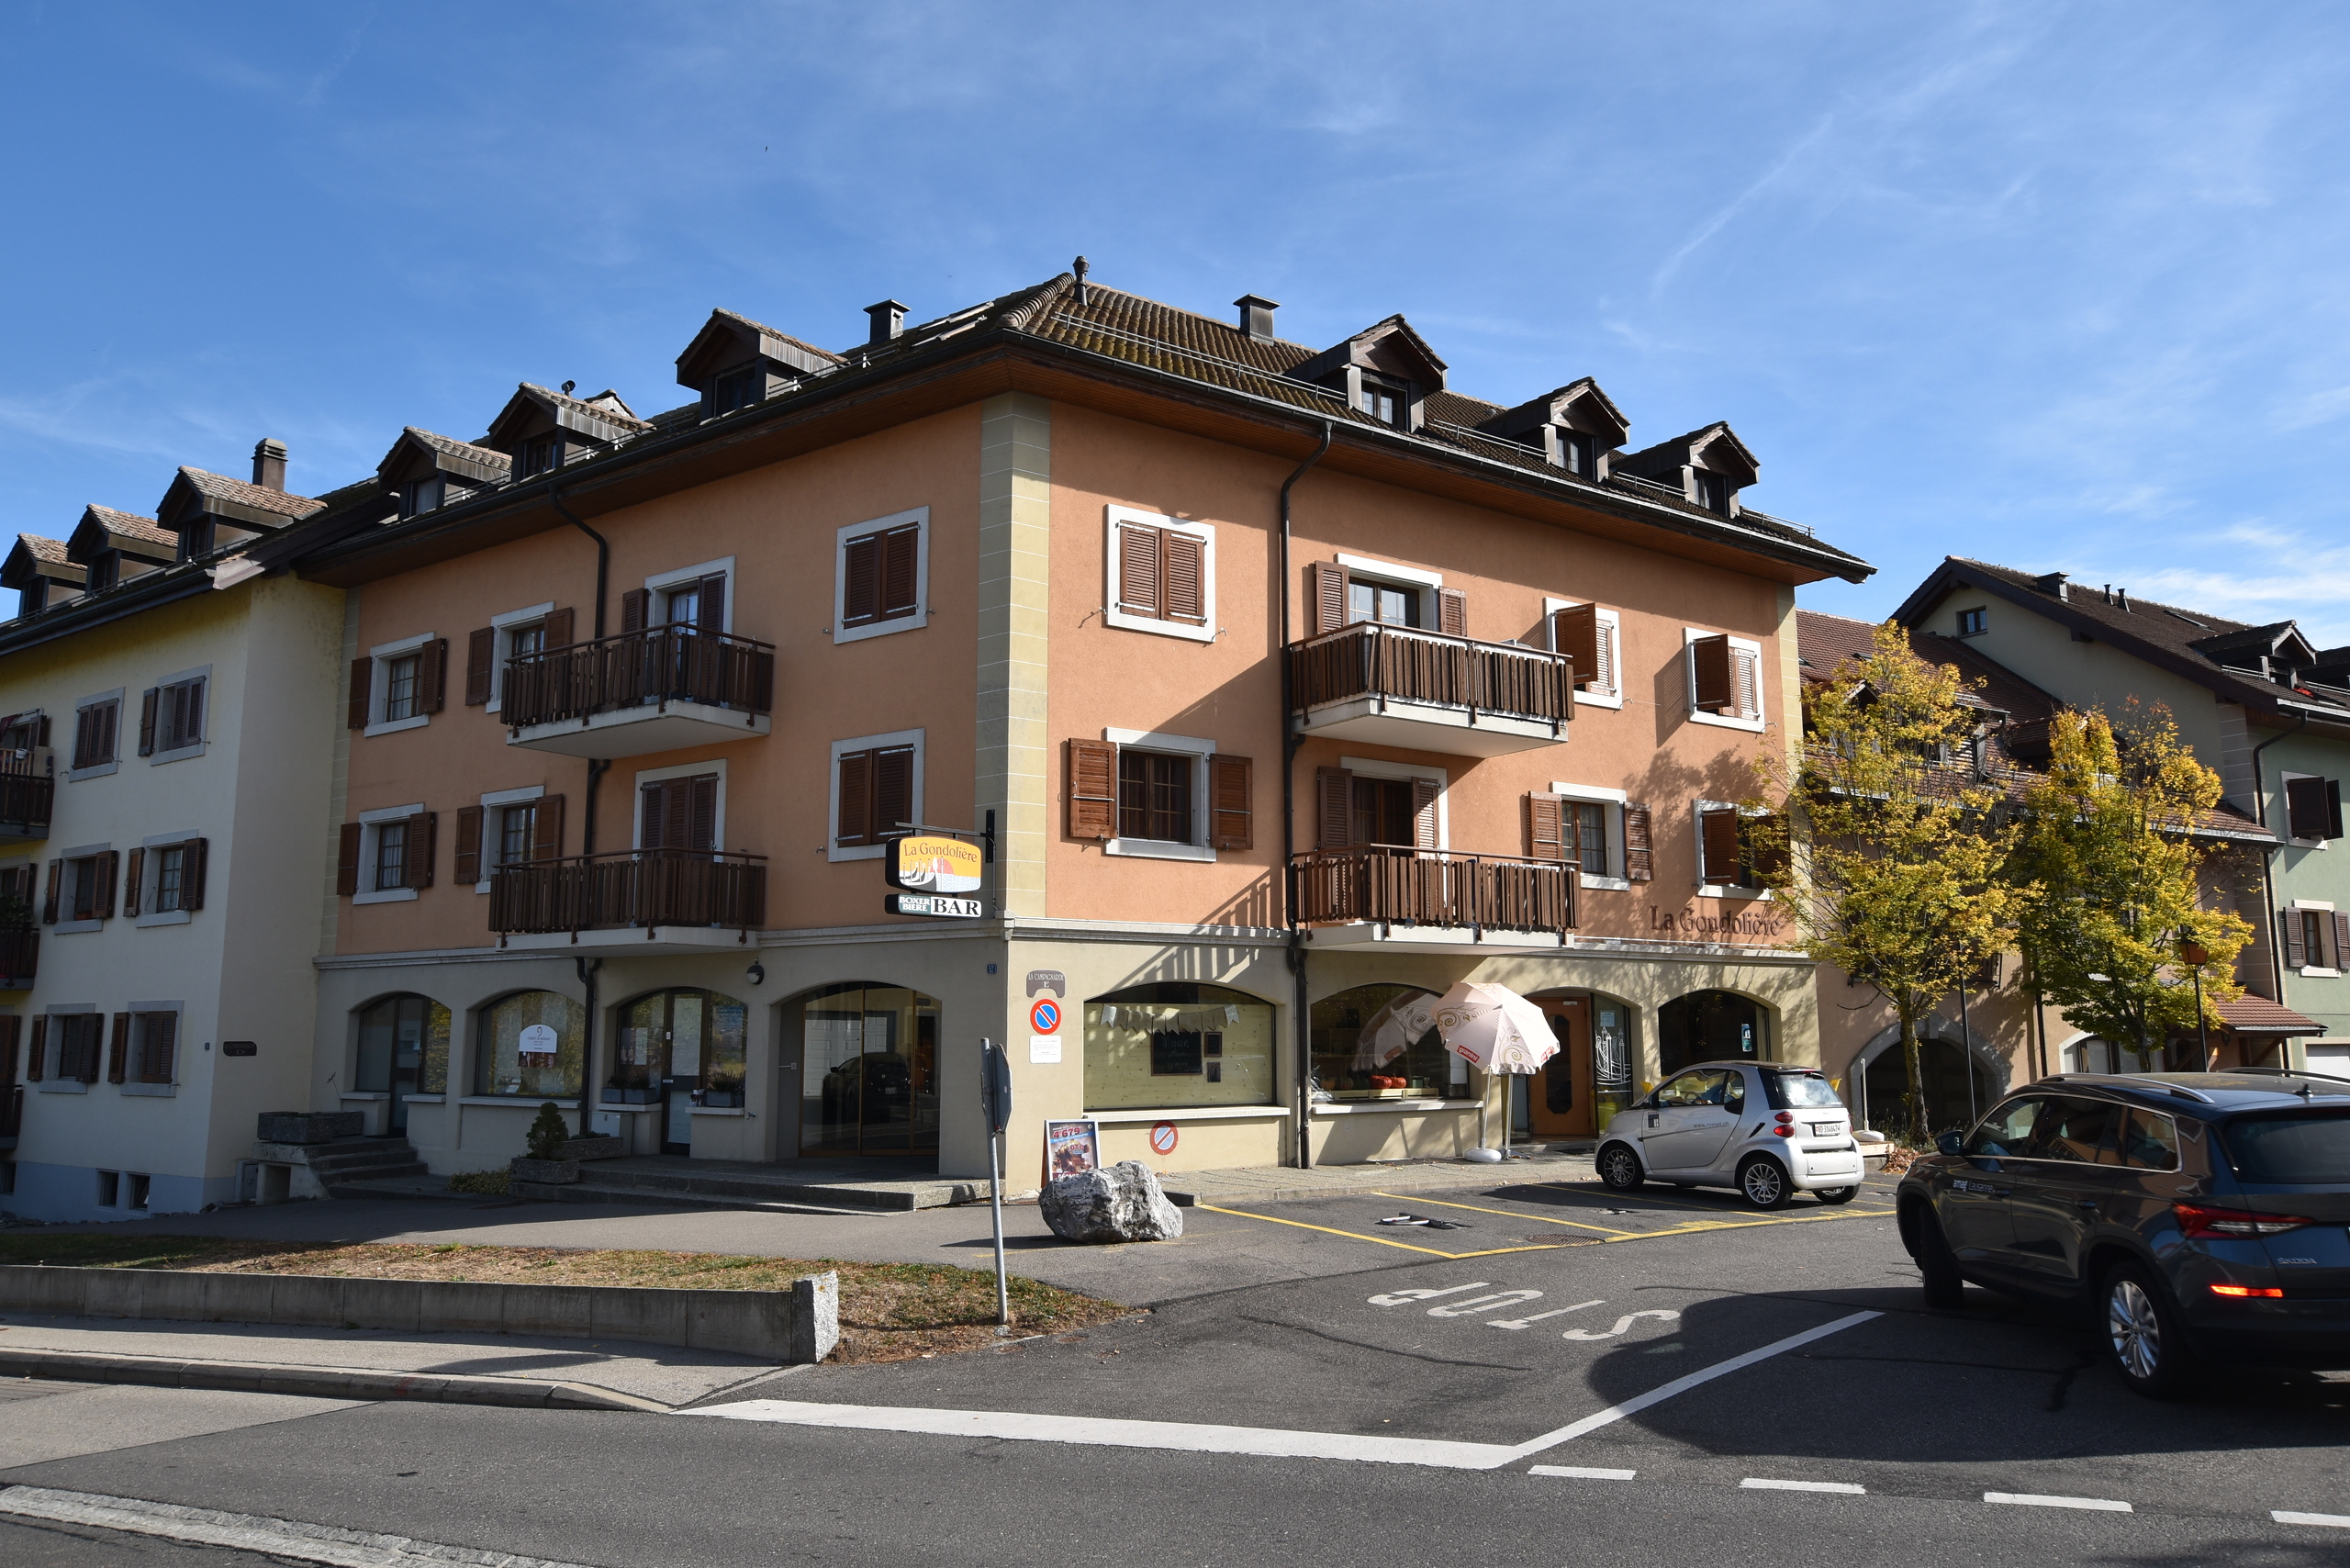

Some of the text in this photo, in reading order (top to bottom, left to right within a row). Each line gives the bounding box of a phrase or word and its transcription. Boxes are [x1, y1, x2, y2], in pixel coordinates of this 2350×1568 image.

[903, 842, 978, 862] La Gondolière
[899, 896, 931, 905] BOXER
[933, 898, 979, 916] BAR
[1651, 905, 1781, 936] La Gondolière
[1458, 1047, 1479, 1061] granini
[1953, 1180, 1994, 1193] amag Lausanne
[1367, 1282, 1682, 1341] STOP
